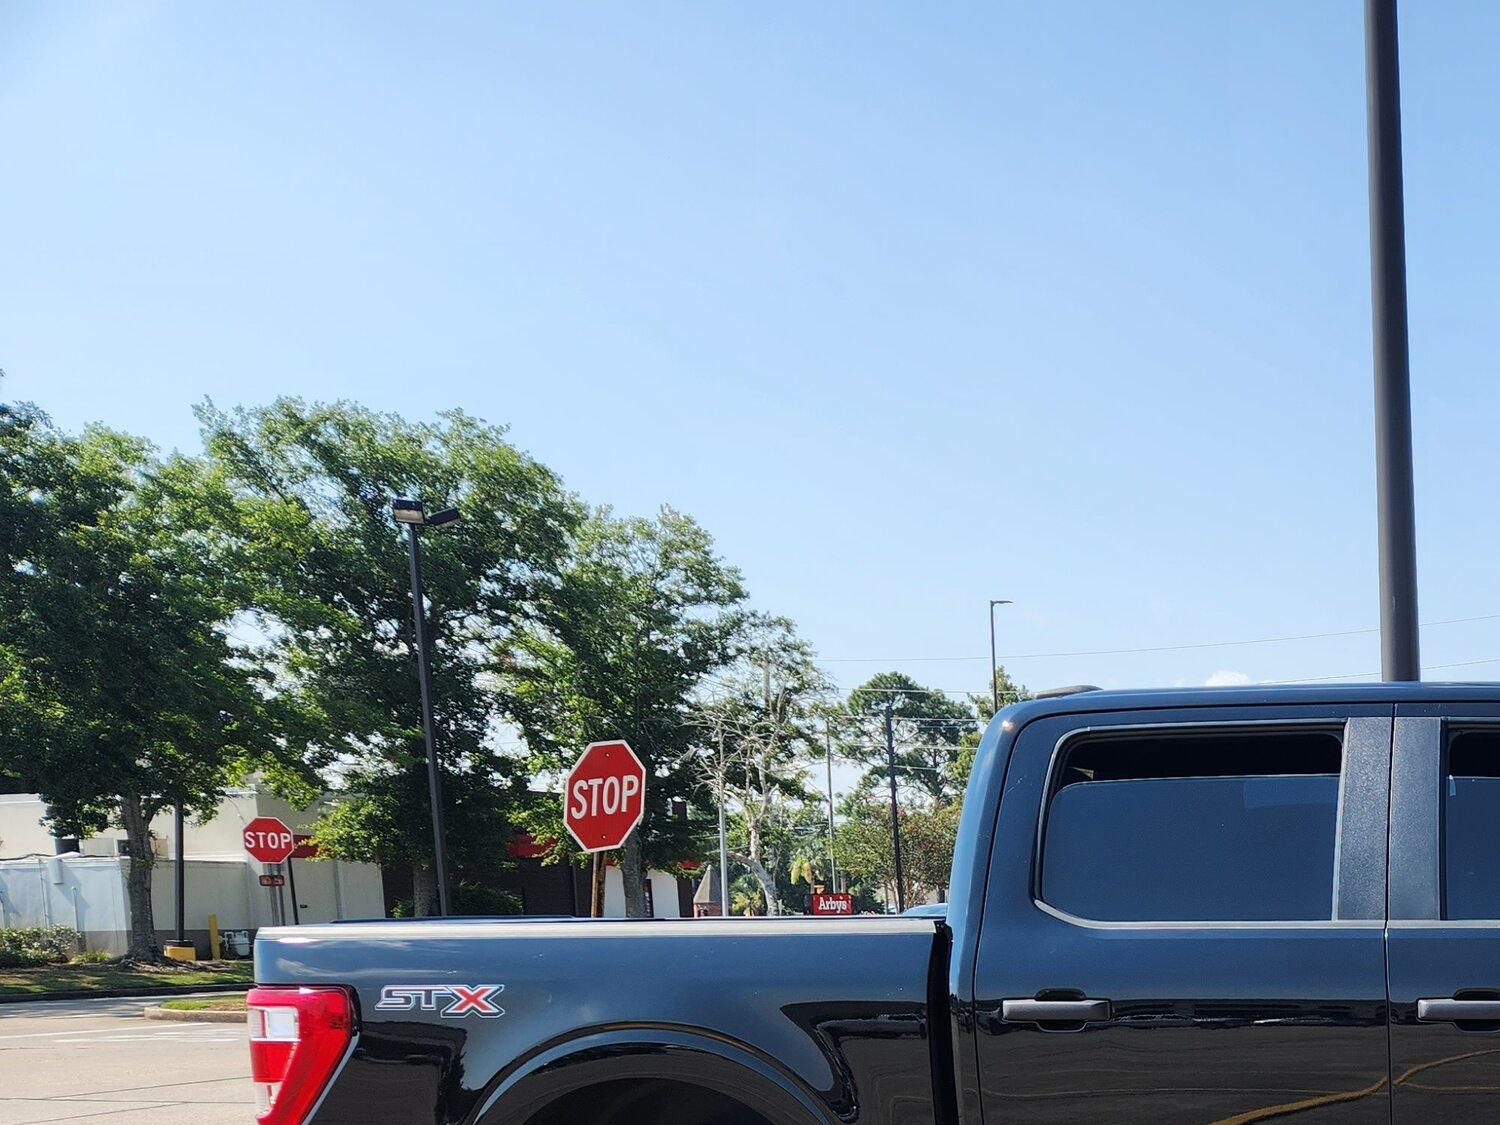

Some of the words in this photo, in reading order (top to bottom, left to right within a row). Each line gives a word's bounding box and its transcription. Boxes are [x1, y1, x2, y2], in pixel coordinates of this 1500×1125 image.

[570, 774, 640, 820] STOP
[245, 831, 291, 849] STOP
[818, 896, 848, 914] Arby's
[375, 985, 505, 1018] STX
